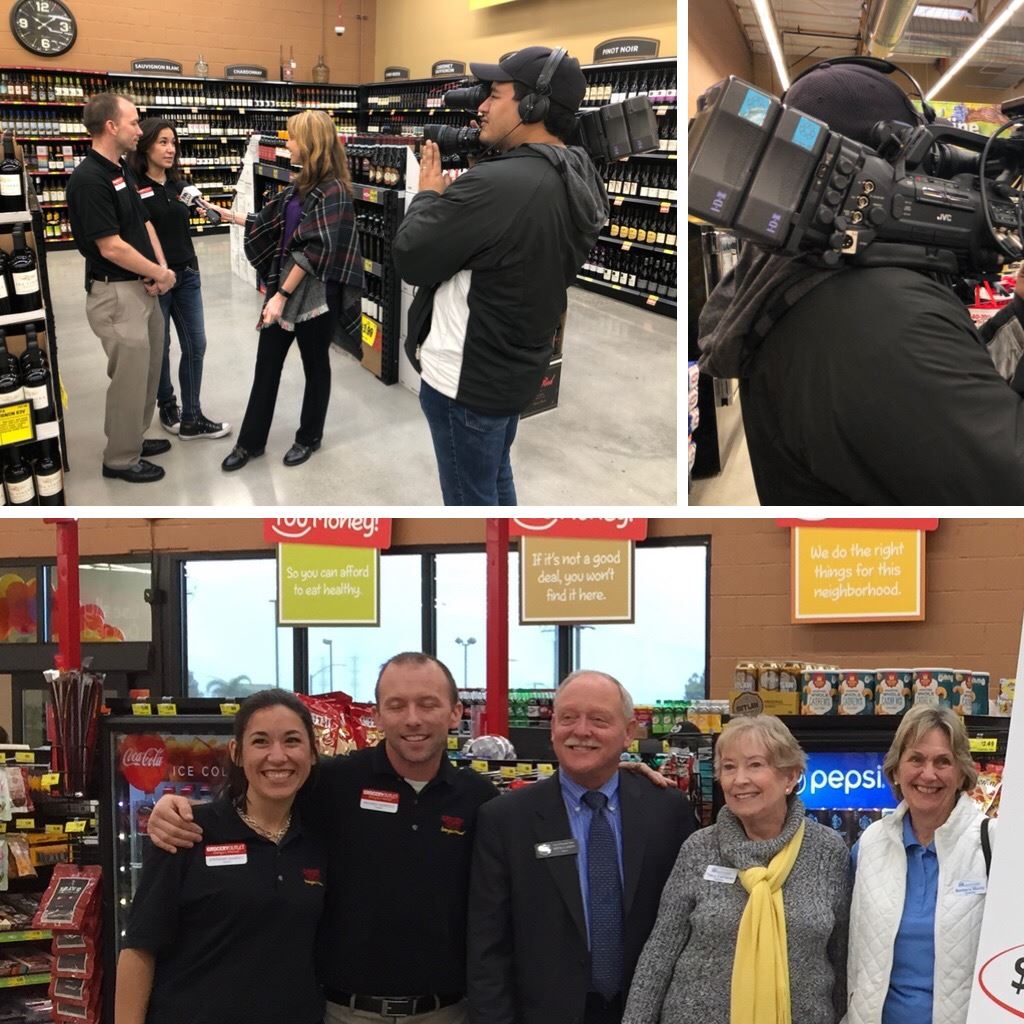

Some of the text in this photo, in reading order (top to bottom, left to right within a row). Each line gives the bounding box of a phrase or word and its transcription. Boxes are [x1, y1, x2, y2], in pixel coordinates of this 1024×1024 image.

[36, 2, 49, 12] 12
[19, 18, 28, 28] 9
[60, 21, 69, 32] 3
[41, 38, 50, 48] 6
[602, 45, 639, 56] PINOT NOIR
[134, 63, 165, 71] SAUVIGNON
[936, 213, 952, 222] JVC
[810, 541, 905, 560] We do the right
[532, 550, 621, 568] If it's not a good
[286, 564, 370, 581] So you can afford
[537, 567, 615, 586] deal, you won't
[814, 562, 901, 582] things for this
[294, 582, 362, 598] to eat healthy.
[546, 588, 607, 602] find it here.
[814, 581, 902, 601] neighborhood.
[172, 766, 228, 777] ICE COL
[810, 765, 882, 795] pepsi
